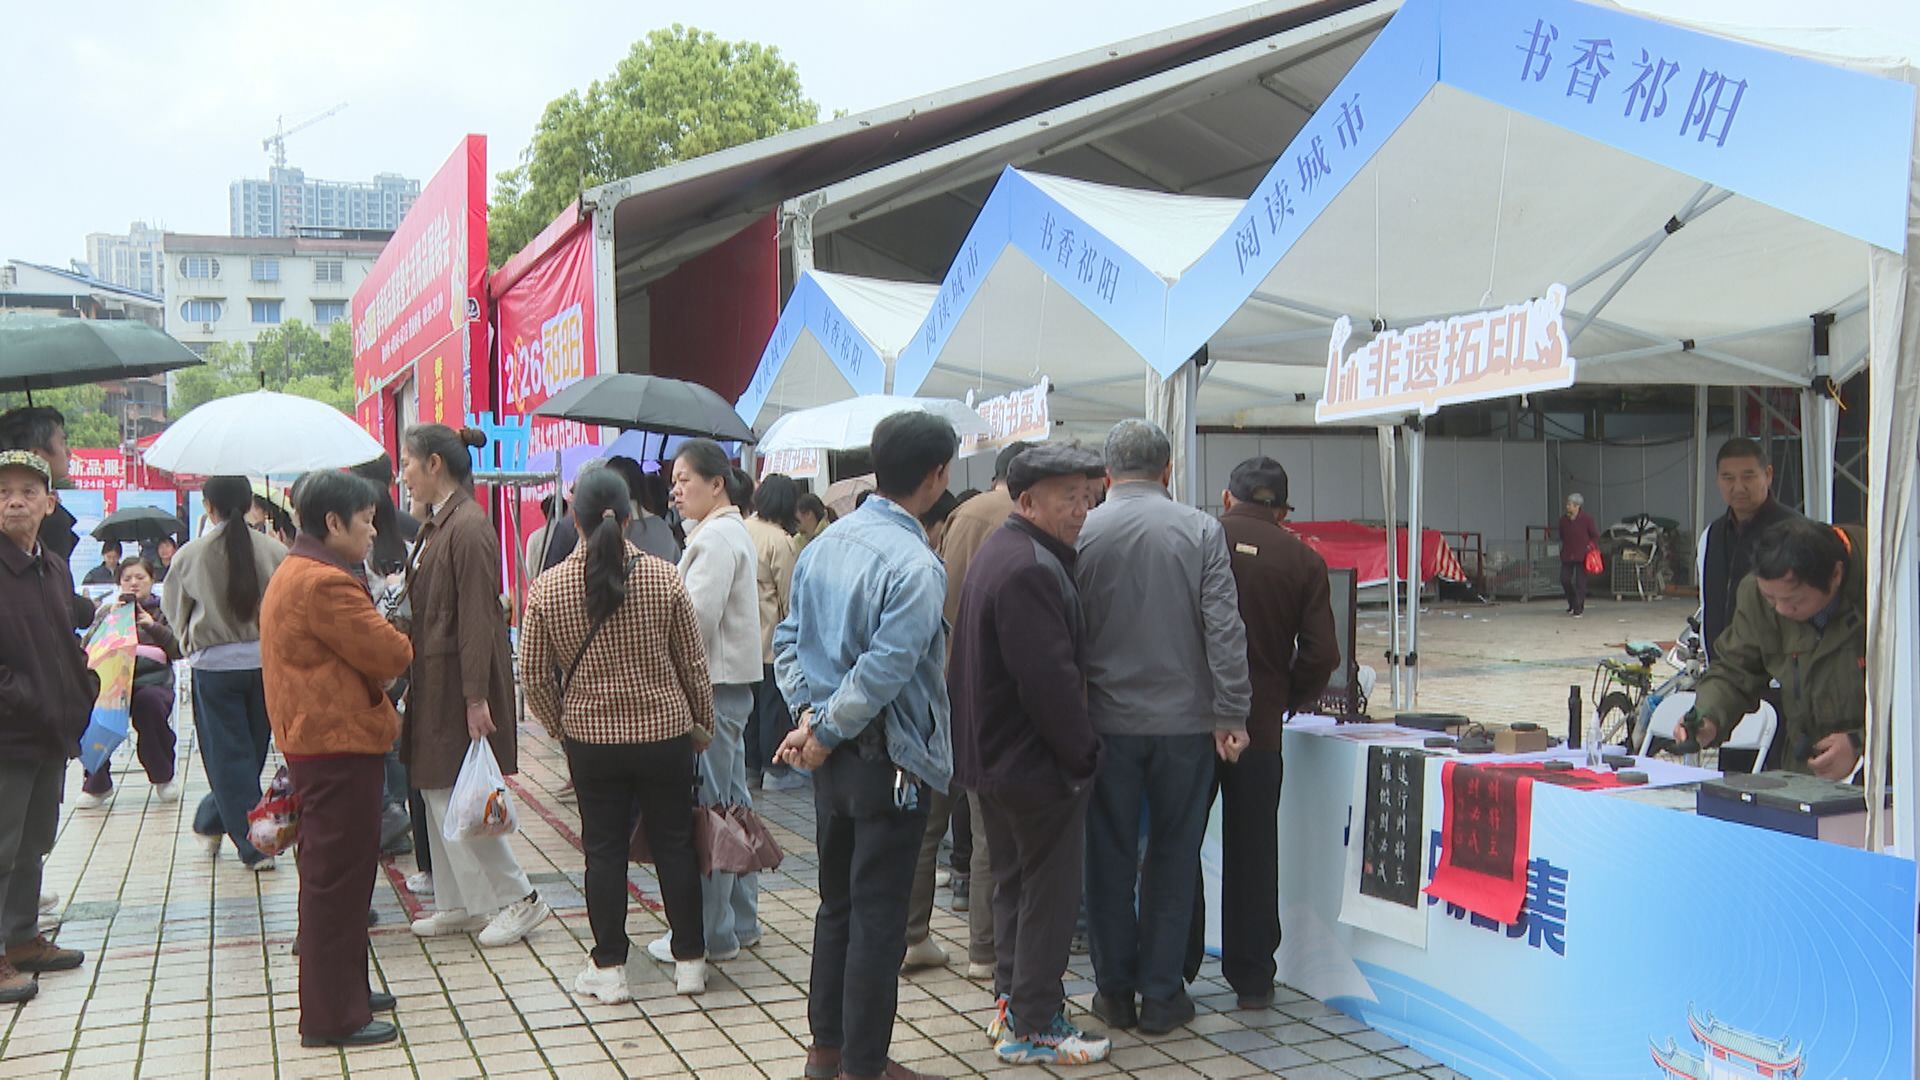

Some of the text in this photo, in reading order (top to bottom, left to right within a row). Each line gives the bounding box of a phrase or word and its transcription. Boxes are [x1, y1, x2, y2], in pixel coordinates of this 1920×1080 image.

[1516, 18, 1749, 148] 书香祁阳
[1235, 93, 1365, 276] 阅读城市
[925, 241, 979, 355] 阅读城市
[1040, 211, 1121, 304] 书香祁阳
[822, 306, 863, 377] 书香祁阳
[1366, 307, 1529, 397] 非遗拓印
[68, 459, 124, 476] 新品服
